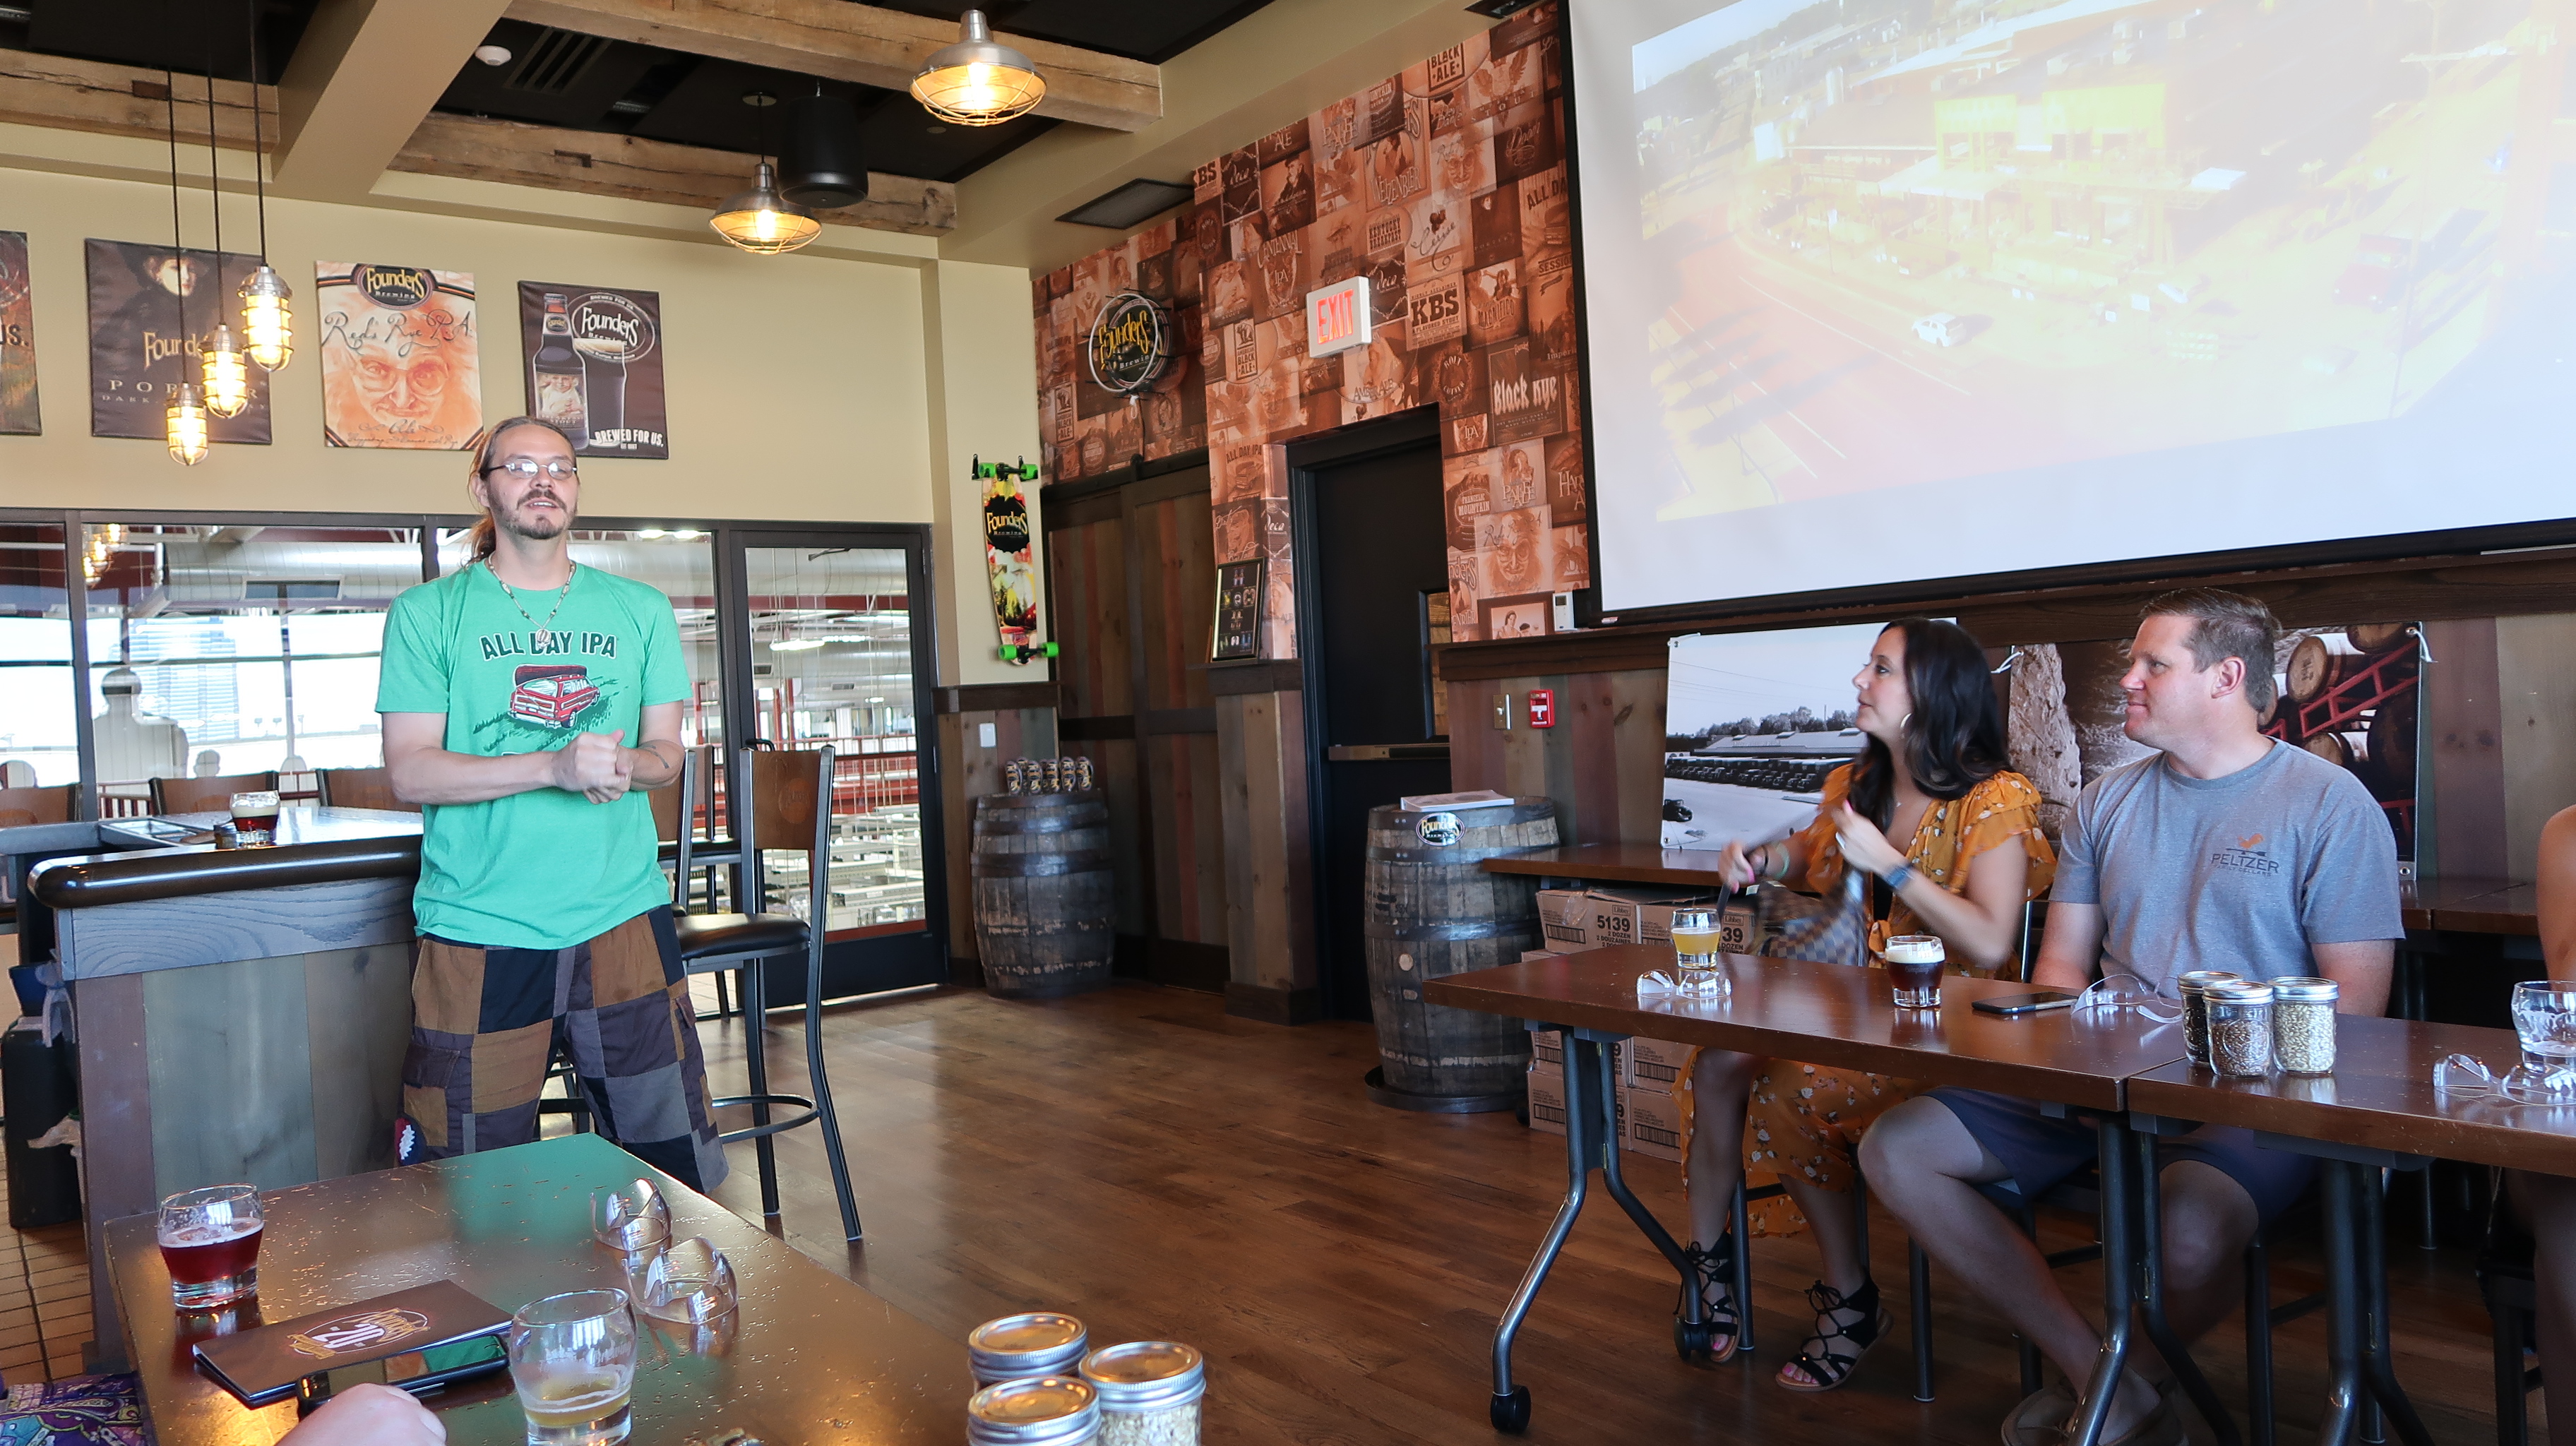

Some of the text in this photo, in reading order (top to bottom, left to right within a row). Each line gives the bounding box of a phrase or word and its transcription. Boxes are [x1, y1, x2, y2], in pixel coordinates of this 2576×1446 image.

[1431, 44, 1460, 68] BLACK
[1527, 177, 1569, 210] ALL DA
[366, 268, 425, 299] Founders
[1275, 268, 1289, 287] IPA
[1316, 288, 1354, 345] EXIT
[1411, 288, 1460, 326] KBS
[581, 306, 639, 348] Founders
[1099, 310, 1150, 371] Founders
[1119, 353, 1152, 369] Brewin
[1237, 352, 1256, 366] BLACK
[1443, 355, 1462, 369] BOLT
[595, 429, 632, 443] BREWED
[633, 429, 649, 443] FOR
[650, 432, 664, 447] US.
[1465, 425, 1479, 441] IPA
[1226, 444, 1263, 464] ALL DAY IPA
[1458, 501, 1491, 516] MOUNTAIN
[986, 511, 1027, 534] Founders
[1448, 555, 1477, 590] nders
[479, 631, 525, 661] ALL
[580, 631, 617, 659] IPA
[2211, 853, 2279, 874] PELTZER
[1614, 907, 1631, 916] Libbey
[1597, 915, 1631, 932] 5139
[311, 1322, 386, 1349] 20
